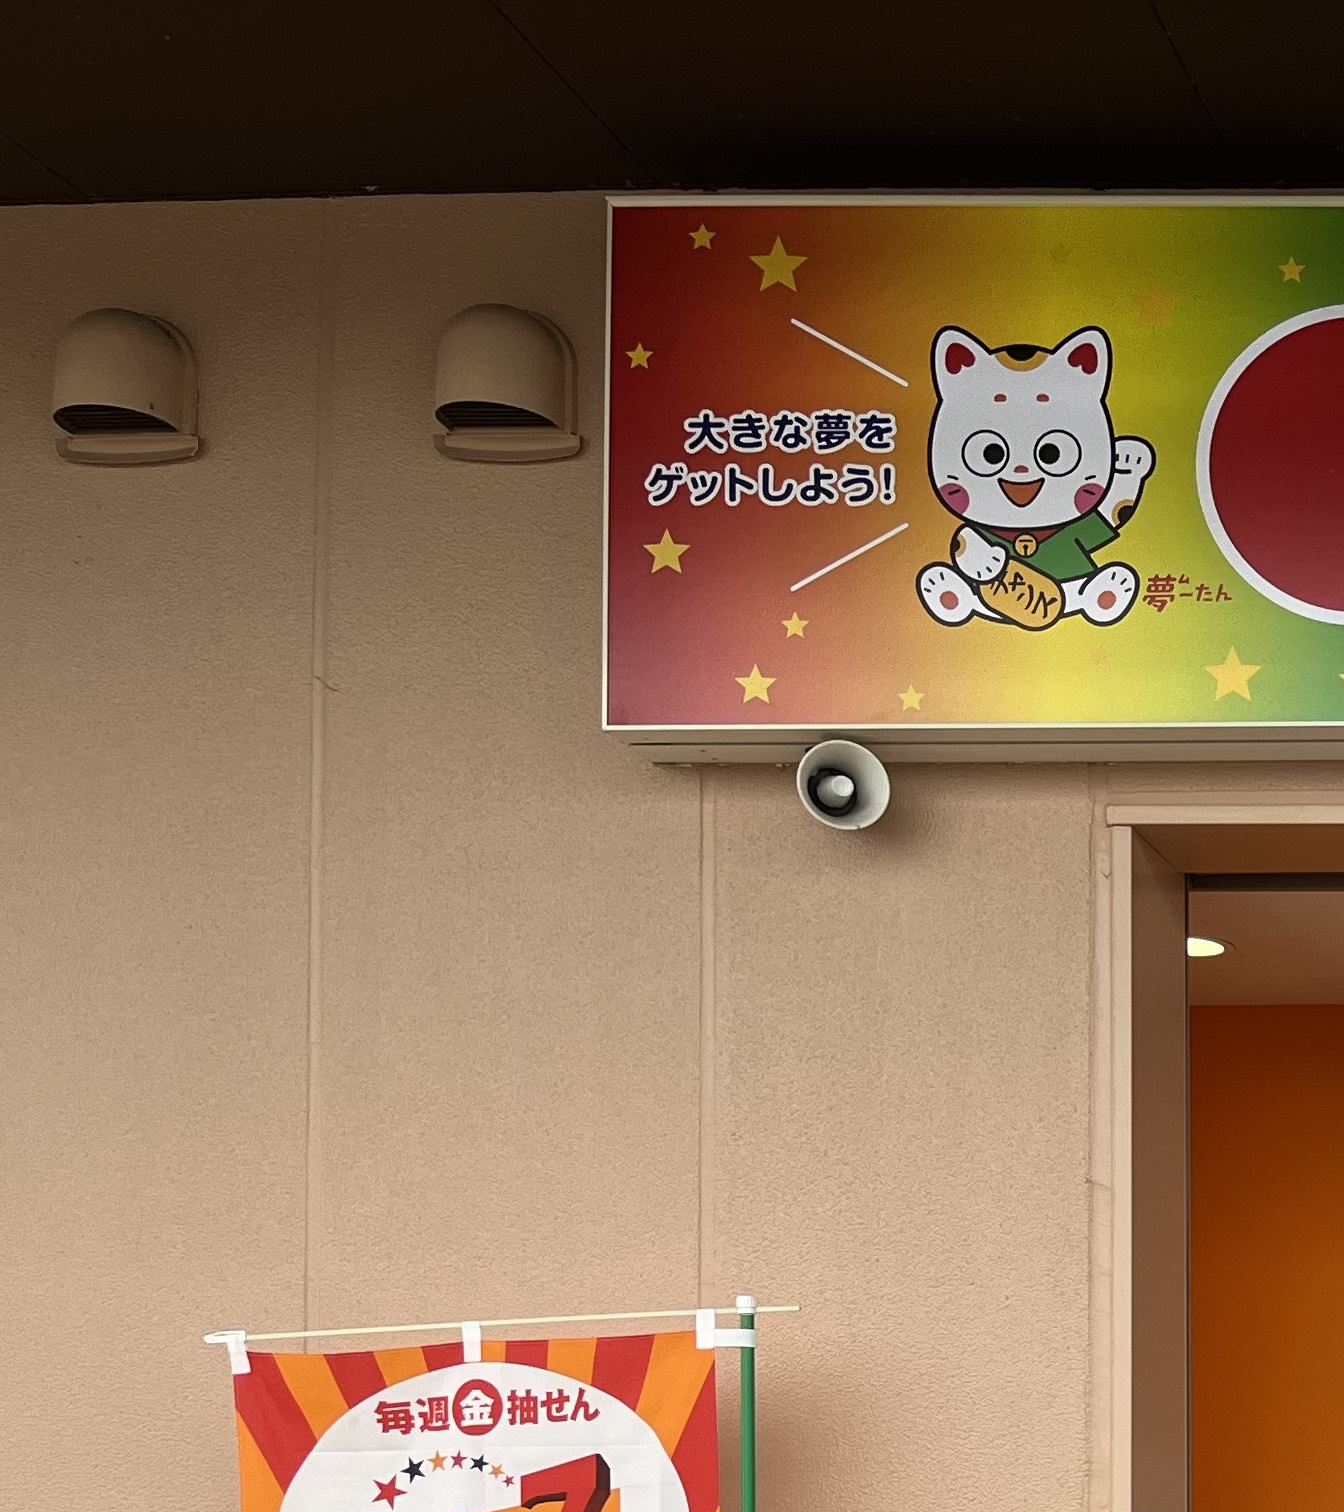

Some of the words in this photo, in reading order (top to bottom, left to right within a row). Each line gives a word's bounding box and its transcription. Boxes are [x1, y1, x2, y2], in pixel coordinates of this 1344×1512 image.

[686, 410, 897, 453] 大きな夢を
[645, 464, 897, 507] ゲットしよう!
